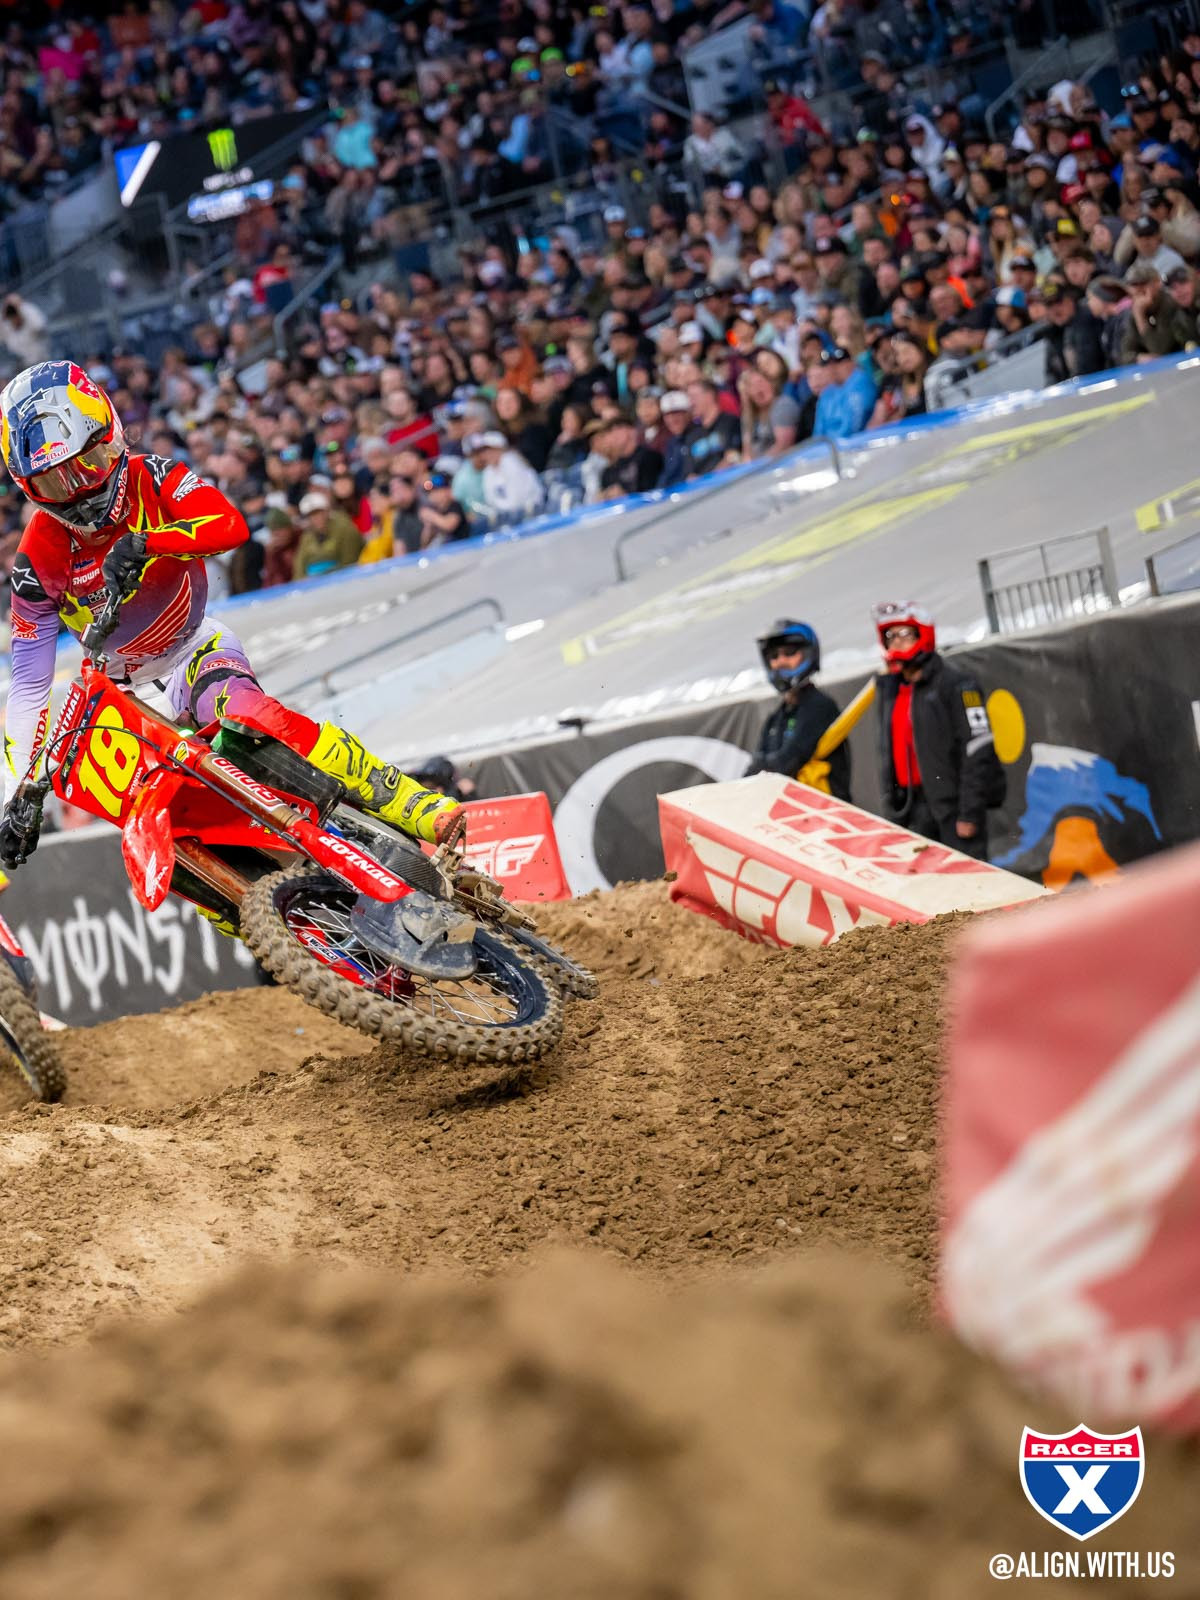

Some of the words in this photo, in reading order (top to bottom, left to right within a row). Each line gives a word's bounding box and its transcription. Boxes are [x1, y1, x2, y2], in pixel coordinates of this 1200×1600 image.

[31, 453, 50, 471] Red
[49, 445, 69, 464] Bull
[72, 567, 100, 586] SHOWA
[78, 704, 141, 818] 18
[317, 834, 400, 889] DUNLOP
[754, 823, 879, 884] RACING
